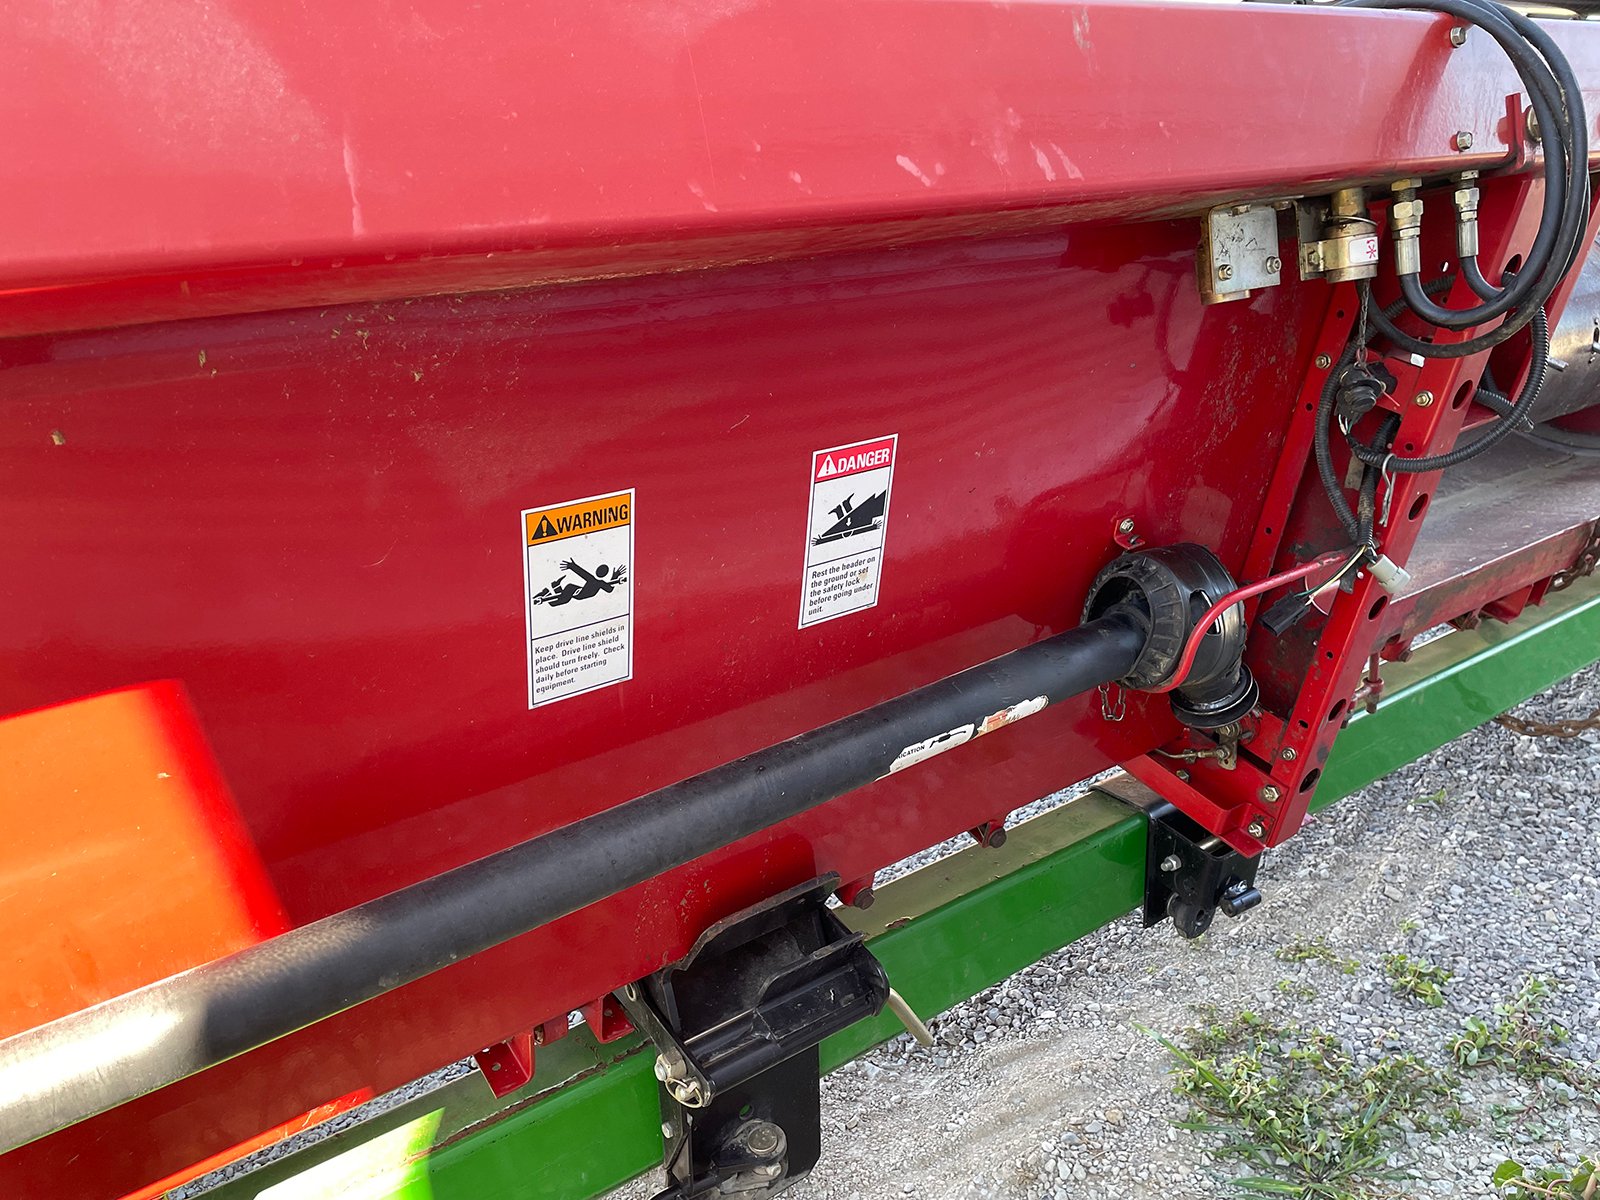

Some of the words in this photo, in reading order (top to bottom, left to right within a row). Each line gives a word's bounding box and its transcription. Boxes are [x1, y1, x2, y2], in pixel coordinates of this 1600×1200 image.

[838, 448, 890, 473] DANGER
[557, 504, 628, 533] WARNING
[811, 580, 822, 588] the
[824, 572, 848, 586] ground
[812, 569, 828, 578] Rest
[842, 559, 865, 570] header
[809, 596, 831, 606] before
[833, 590, 852, 601] going
[854, 583, 873, 593] under
[810, 589, 821, 597] the
[823, 583, 844, 594] safety
[845, 577, 860, 587] lock
[808, 606, 823, 615] unit.
[535, 644, 553, 654] Keep
[556, 639, 574, 648] drive
[591, 628, 616, 638] shields
[535, 654, 558, 665] place.
[562, 646, 580, 656] Drive
[582, 643, 596, 651] line
[598, 635, 619, 646] shield
[536, 662, 560, 673] should
[578, 652, 600, 662] freely.
[603, 643, 624, 654] Check
[536, 673, 554, 683] daily
[556, 666, 578, 678] before
[580, 659, 607, 671] starting
[536, 677, 575, 694] equipment.
